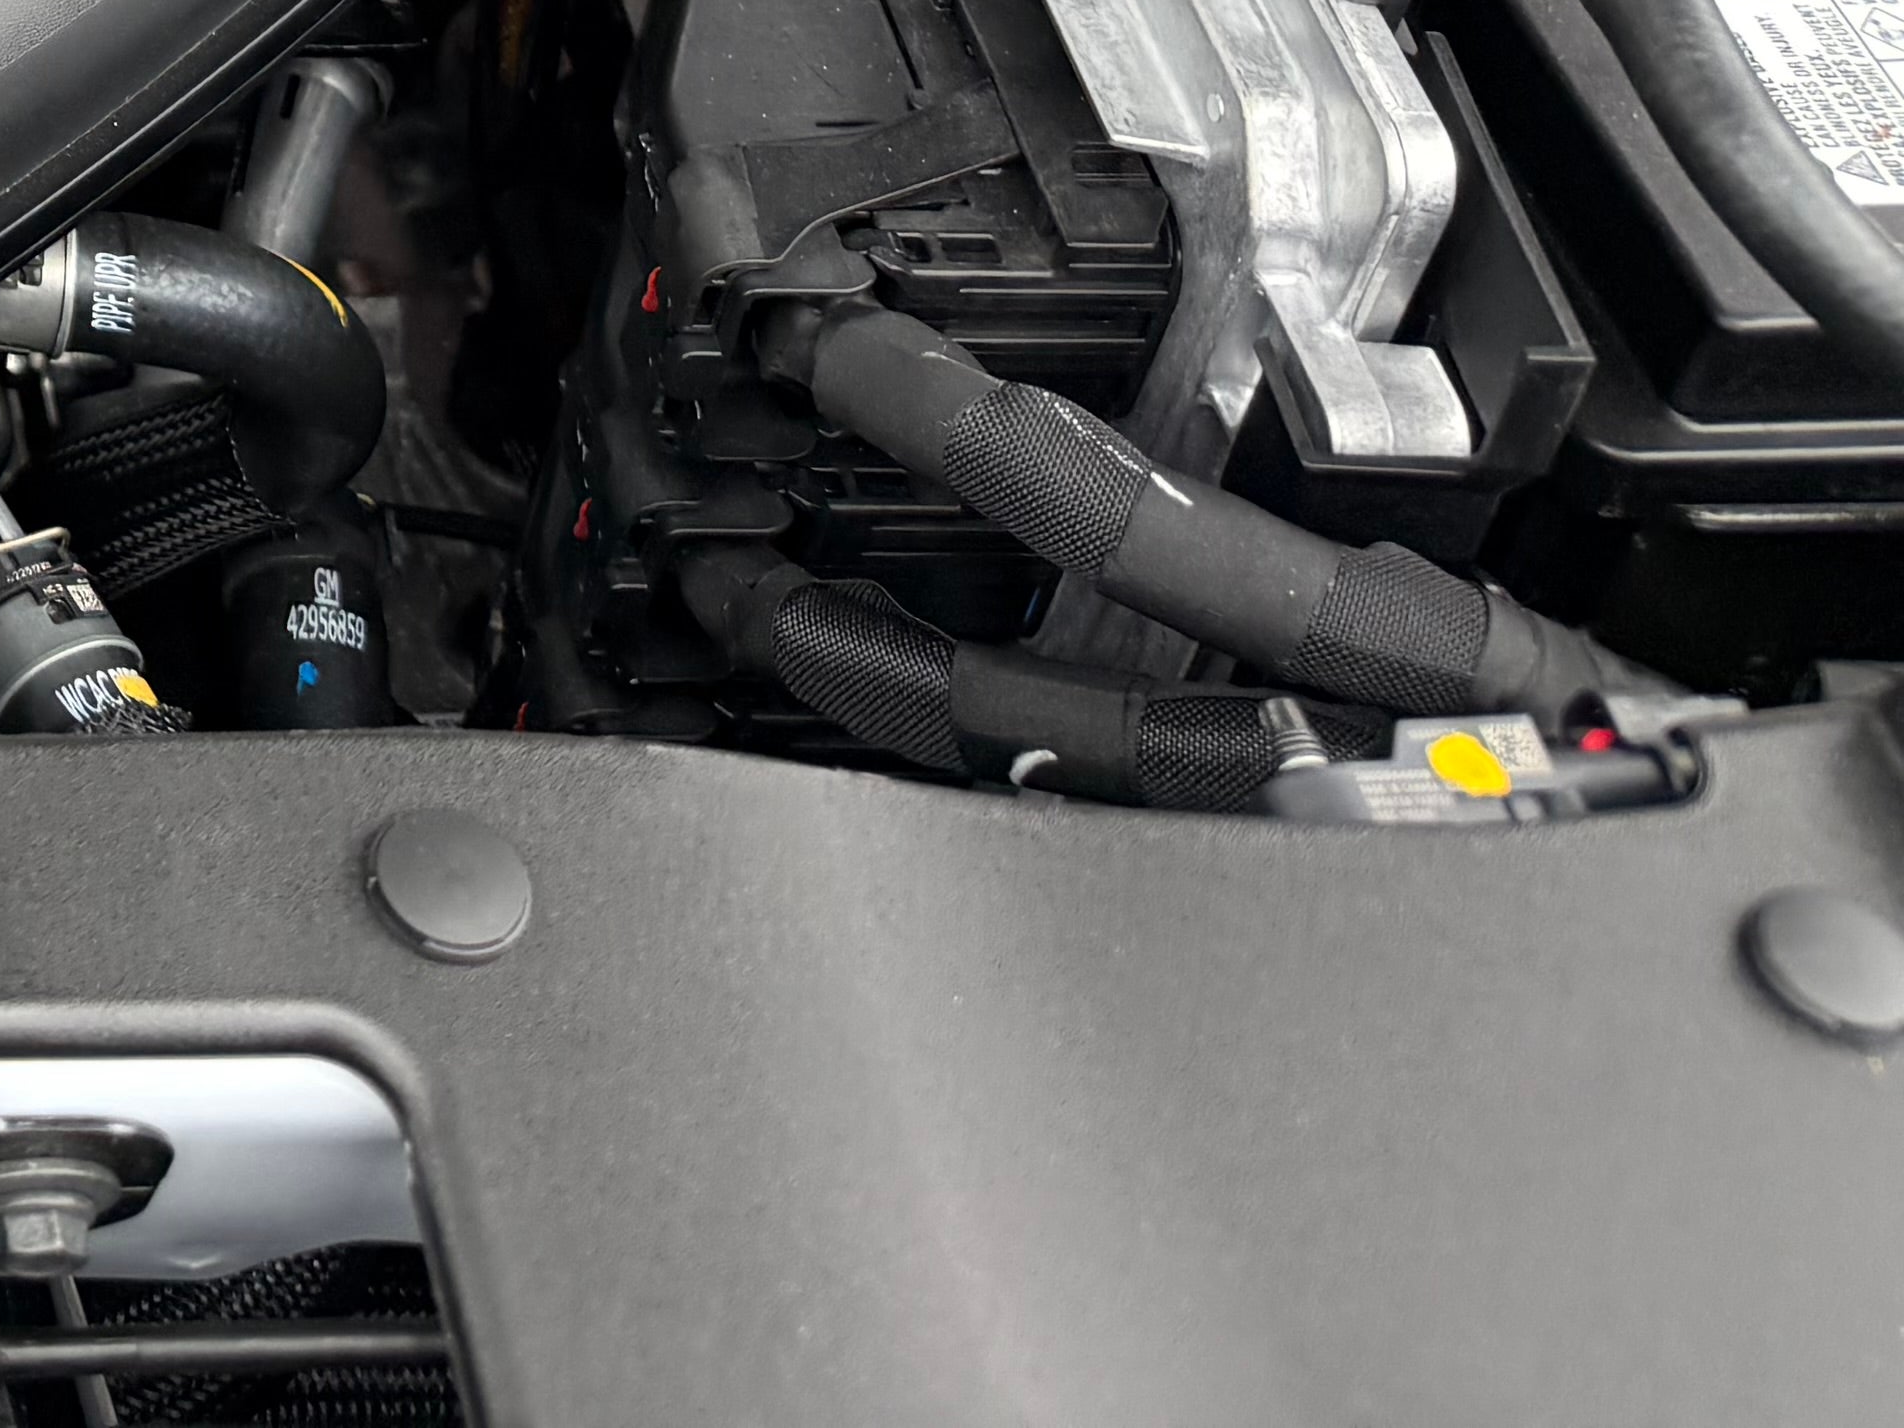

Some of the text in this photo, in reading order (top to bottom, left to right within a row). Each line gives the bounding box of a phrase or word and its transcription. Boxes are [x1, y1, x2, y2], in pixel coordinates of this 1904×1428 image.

[1790, 3, 1844, 55] PEUVENT
[1813, 6, 1866, 57] AVEUGLE
[1785, 60, 1812, 76] OR
[1800, 49, 1843, 85] YEUX.
[1778, 81, 1841, 147] CAN CAUSE
[1800, 80, 1863, 146] BLINDNESS
[1831, 91, 1864, 114] LES
[92, 252, 136, 290] UPR
[313, 566, 339, 602] GM
[286, 603, 366, 650] 42956859
[54, 669, 122, 723] WCAC
